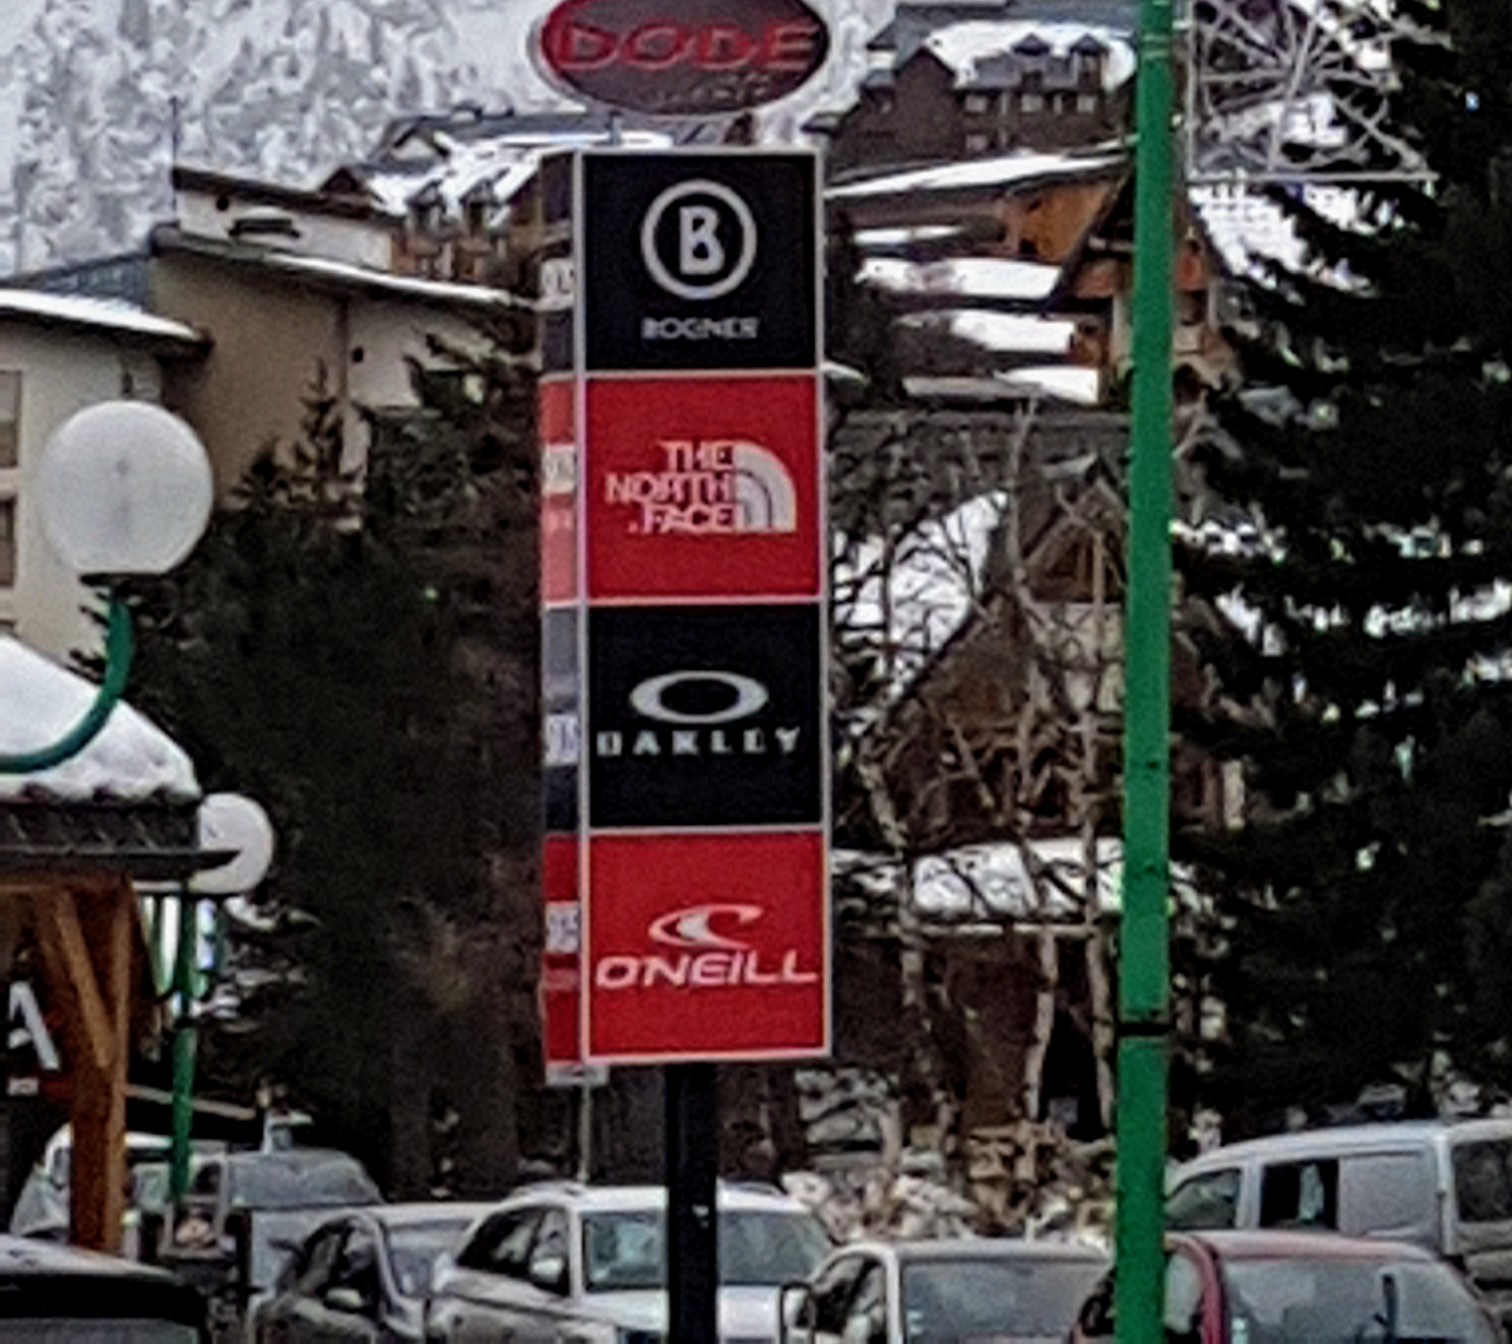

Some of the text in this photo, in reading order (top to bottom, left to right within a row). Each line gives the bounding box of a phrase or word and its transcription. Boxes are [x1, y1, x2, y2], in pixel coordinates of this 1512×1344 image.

[679, 205, 725, 275] B
[657, 440, 733, 470] THE
[604, 471, 735, 503] NORTH
[596, 727, 800, 757] OAKLEY
